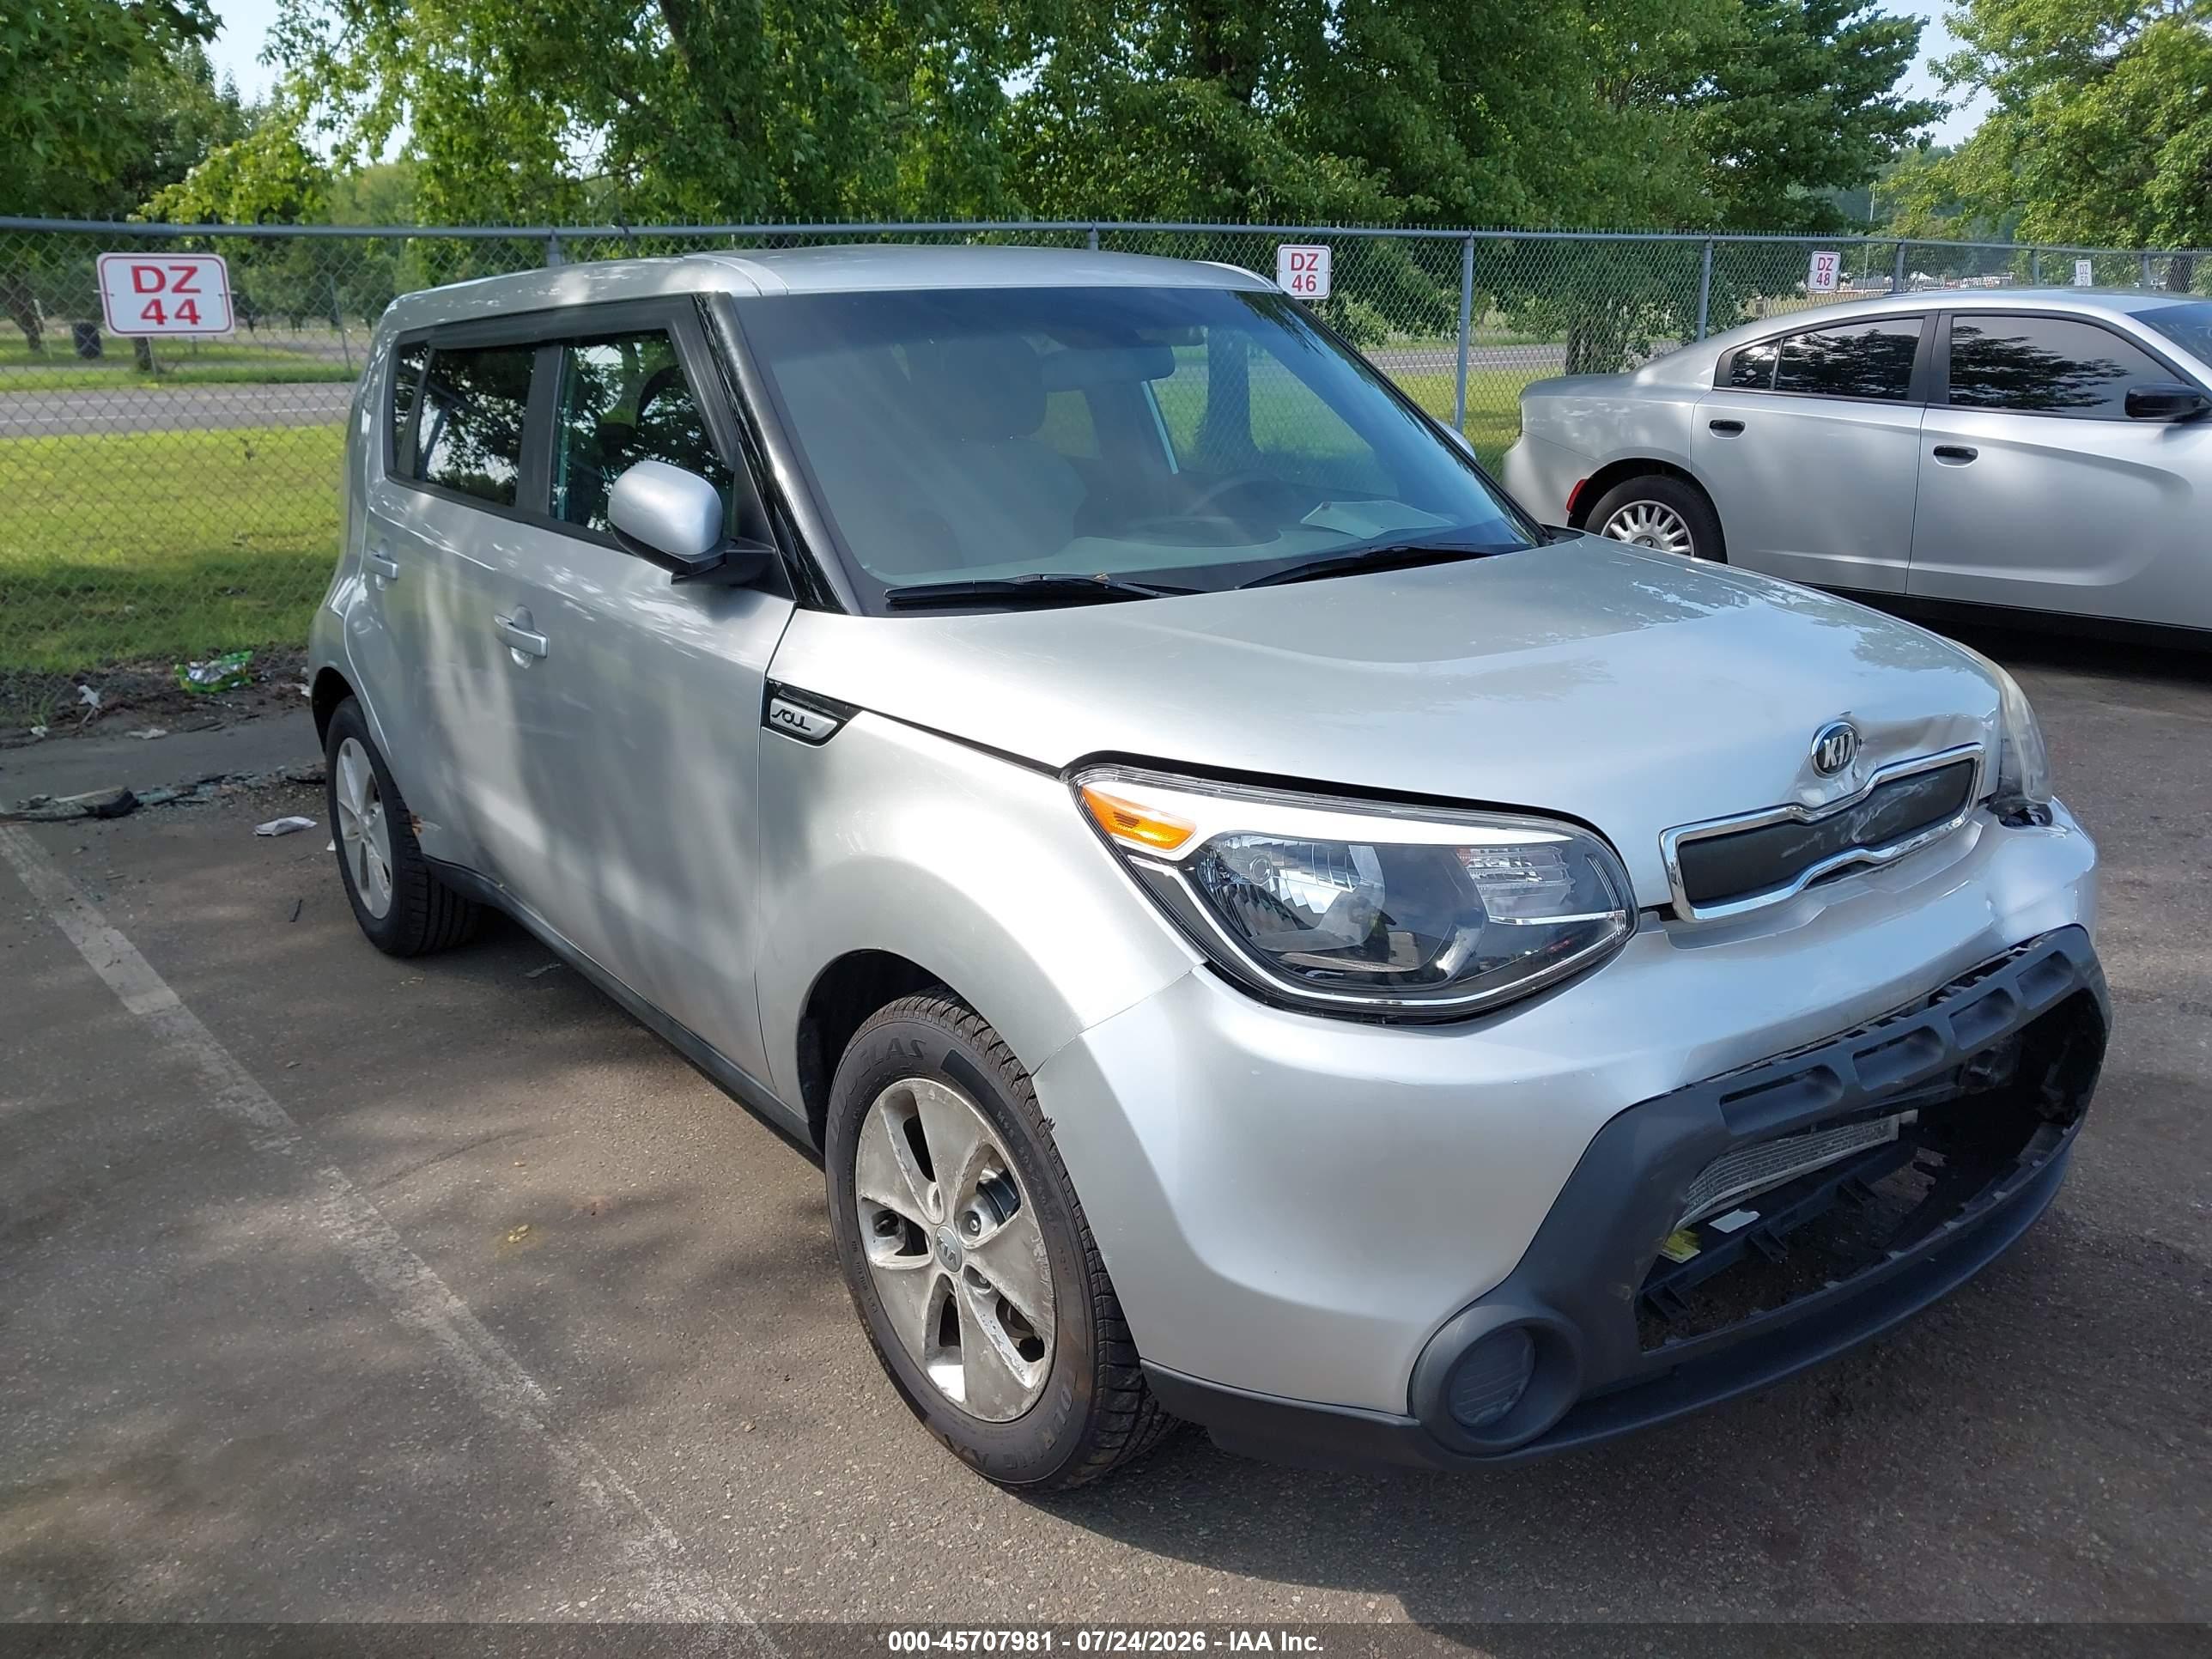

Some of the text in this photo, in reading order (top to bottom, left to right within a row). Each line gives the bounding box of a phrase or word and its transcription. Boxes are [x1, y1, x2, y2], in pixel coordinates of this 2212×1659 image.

[1291, 252, 1319, 271] DZ
[1817, 257, 1834, 271] DZ
[2079, 264, 2088, 275] DZ
[131, 265, 202, 294] DZ
[1291, 274, 1317, 292] 46
[1816, 272, 1831, 286] 48
[140, 299, 202, 325] 44
[1823, 731, 1855, 769] KIA
[937, 1233, 957, 1267] KIA
